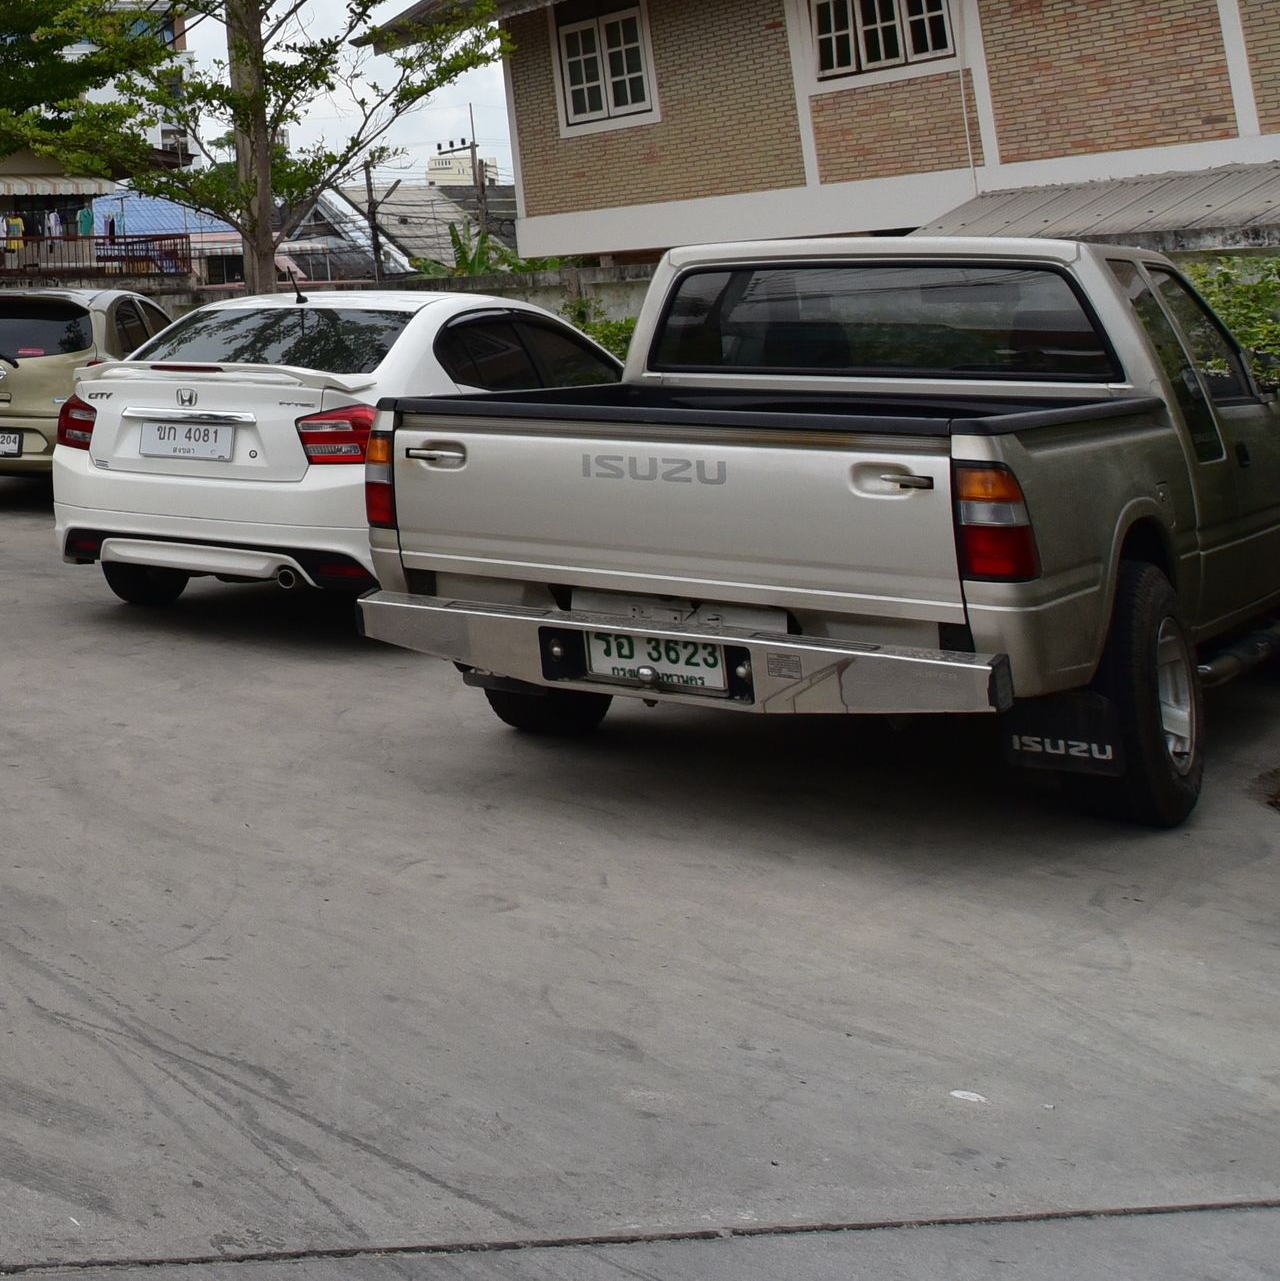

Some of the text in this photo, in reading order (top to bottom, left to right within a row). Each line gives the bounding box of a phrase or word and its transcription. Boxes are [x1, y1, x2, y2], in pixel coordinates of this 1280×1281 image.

[184, 427, 219, 444] 4081
[582, 453, 727, 485] ISUZU
[646, 637, 719, 669] 3623
[1012, 734, 1113, 760] ISUZU
